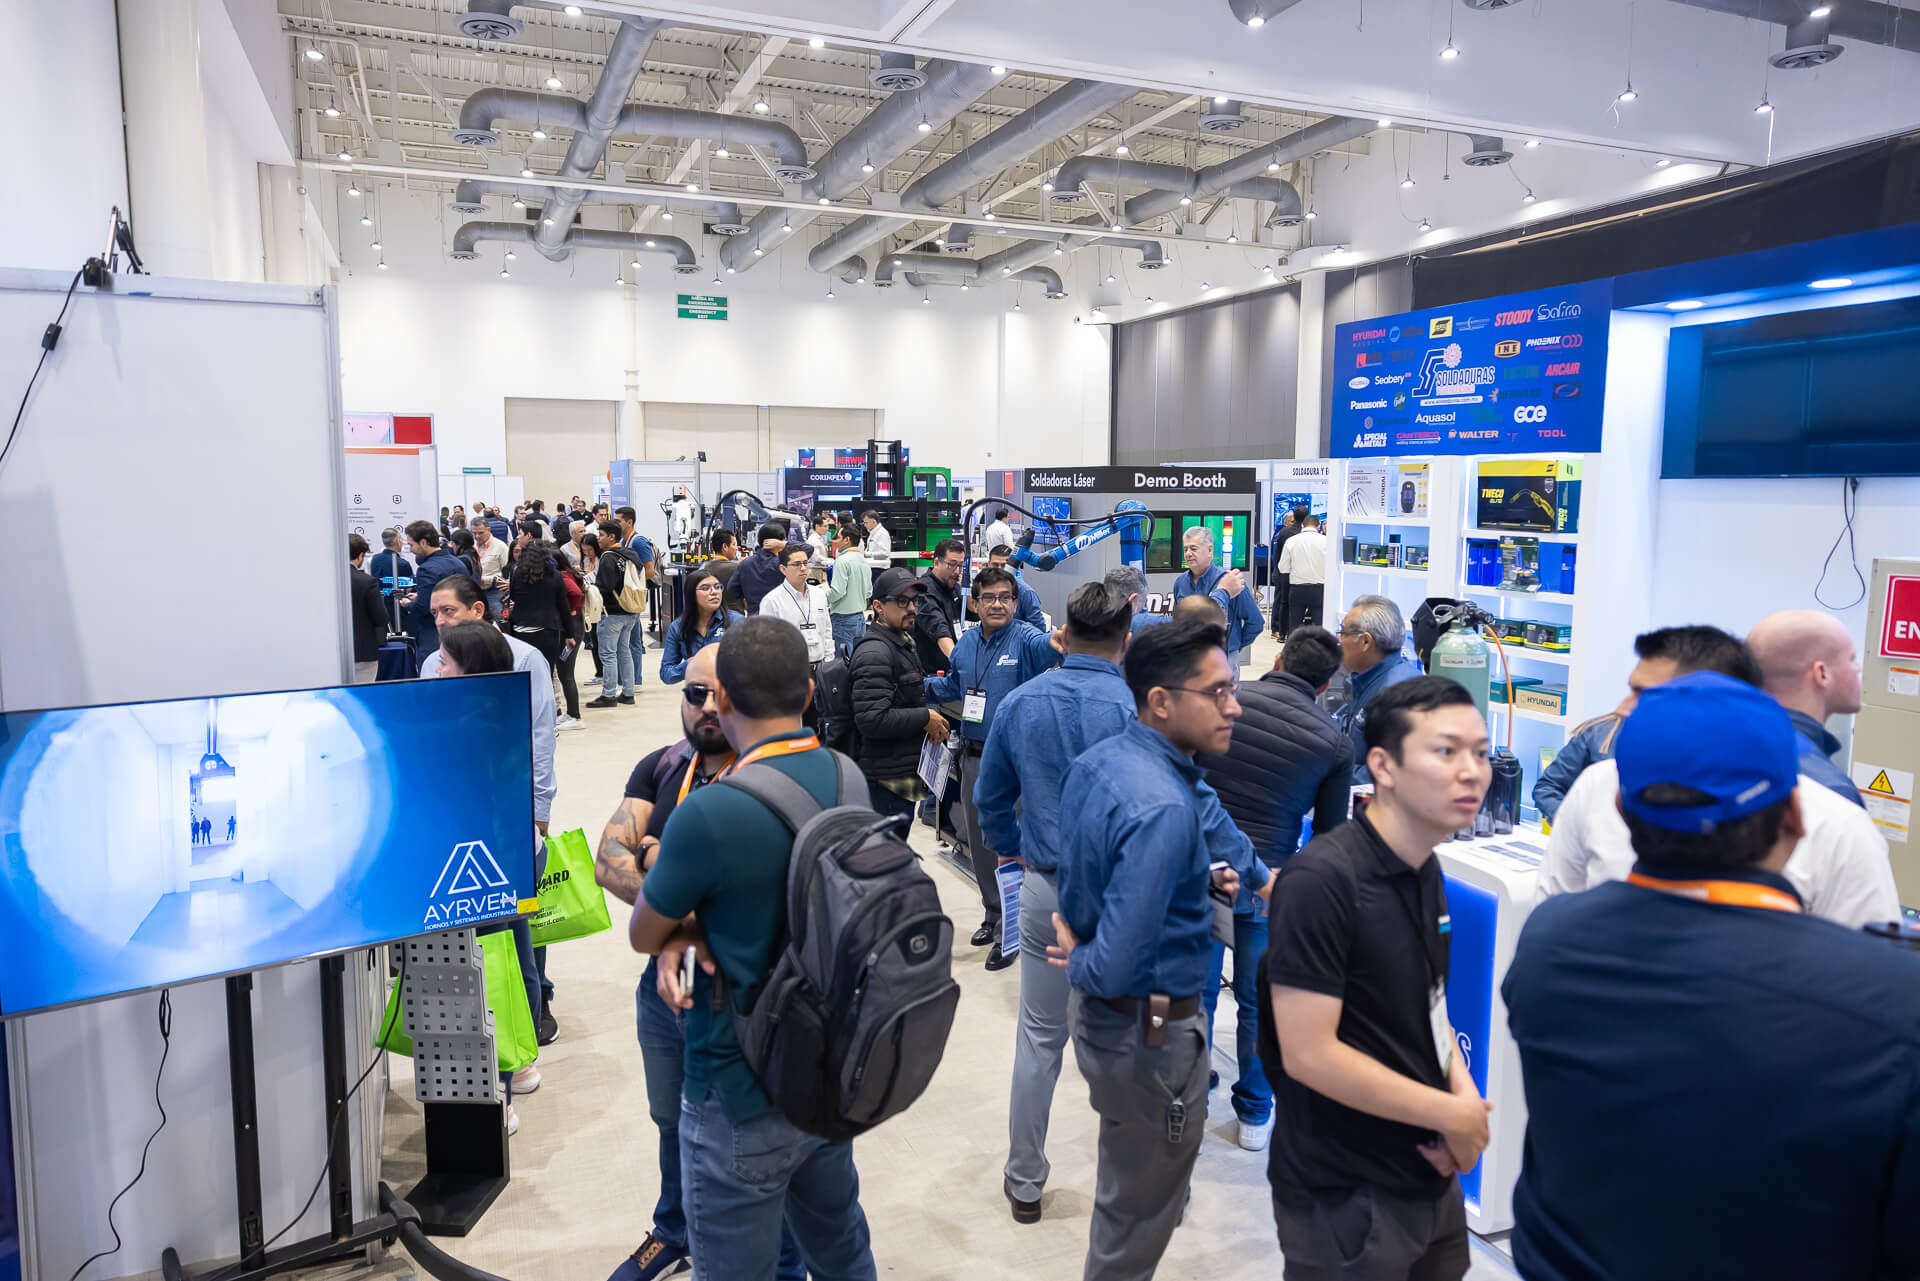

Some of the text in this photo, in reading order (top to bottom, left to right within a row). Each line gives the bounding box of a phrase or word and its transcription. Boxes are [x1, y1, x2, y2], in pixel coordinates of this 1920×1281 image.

[1494, 309, 1534, 327] STOODY
[1352, 328, 1386, 342] HYUNDAI
[1498, 344, 1517, 353] INE
[1545, 362, 1580, 376] ARCAIR
[1374, 374, 1405, 385] Seabery
[1436, 366, 1496, 386] SOLDADURAS
[1350, 398, 1388, 410] Panasonic
[1414, 412, 1456, 424] Aquasol
[1363, 432, 1387, 441] SPECIAL
[1459, 430, 1499, 439] WALTER
[1537, 429, 1567, 437] TOOL
[1363, 440, 1387, 448] METALS
[1292, 467, 1320, 476] SOLDADURA
[1030, 473, 1096, 488] Soldadoras Láser
[1134, 473, 1227, 488] Demo Booth
[1481, 488, 1504, 499] TWECO
[1089, 527, 1111, 540] Miller
[1527, 696, 1558, 709] HYUNDAI
[423, 889, 518, 923] AYRVEN
[424, 922, 449, 931] HORNOS
[454, 915, 480, 926] SISTEMAS
[480, 908, 518, 921] INDUSTRIALES
